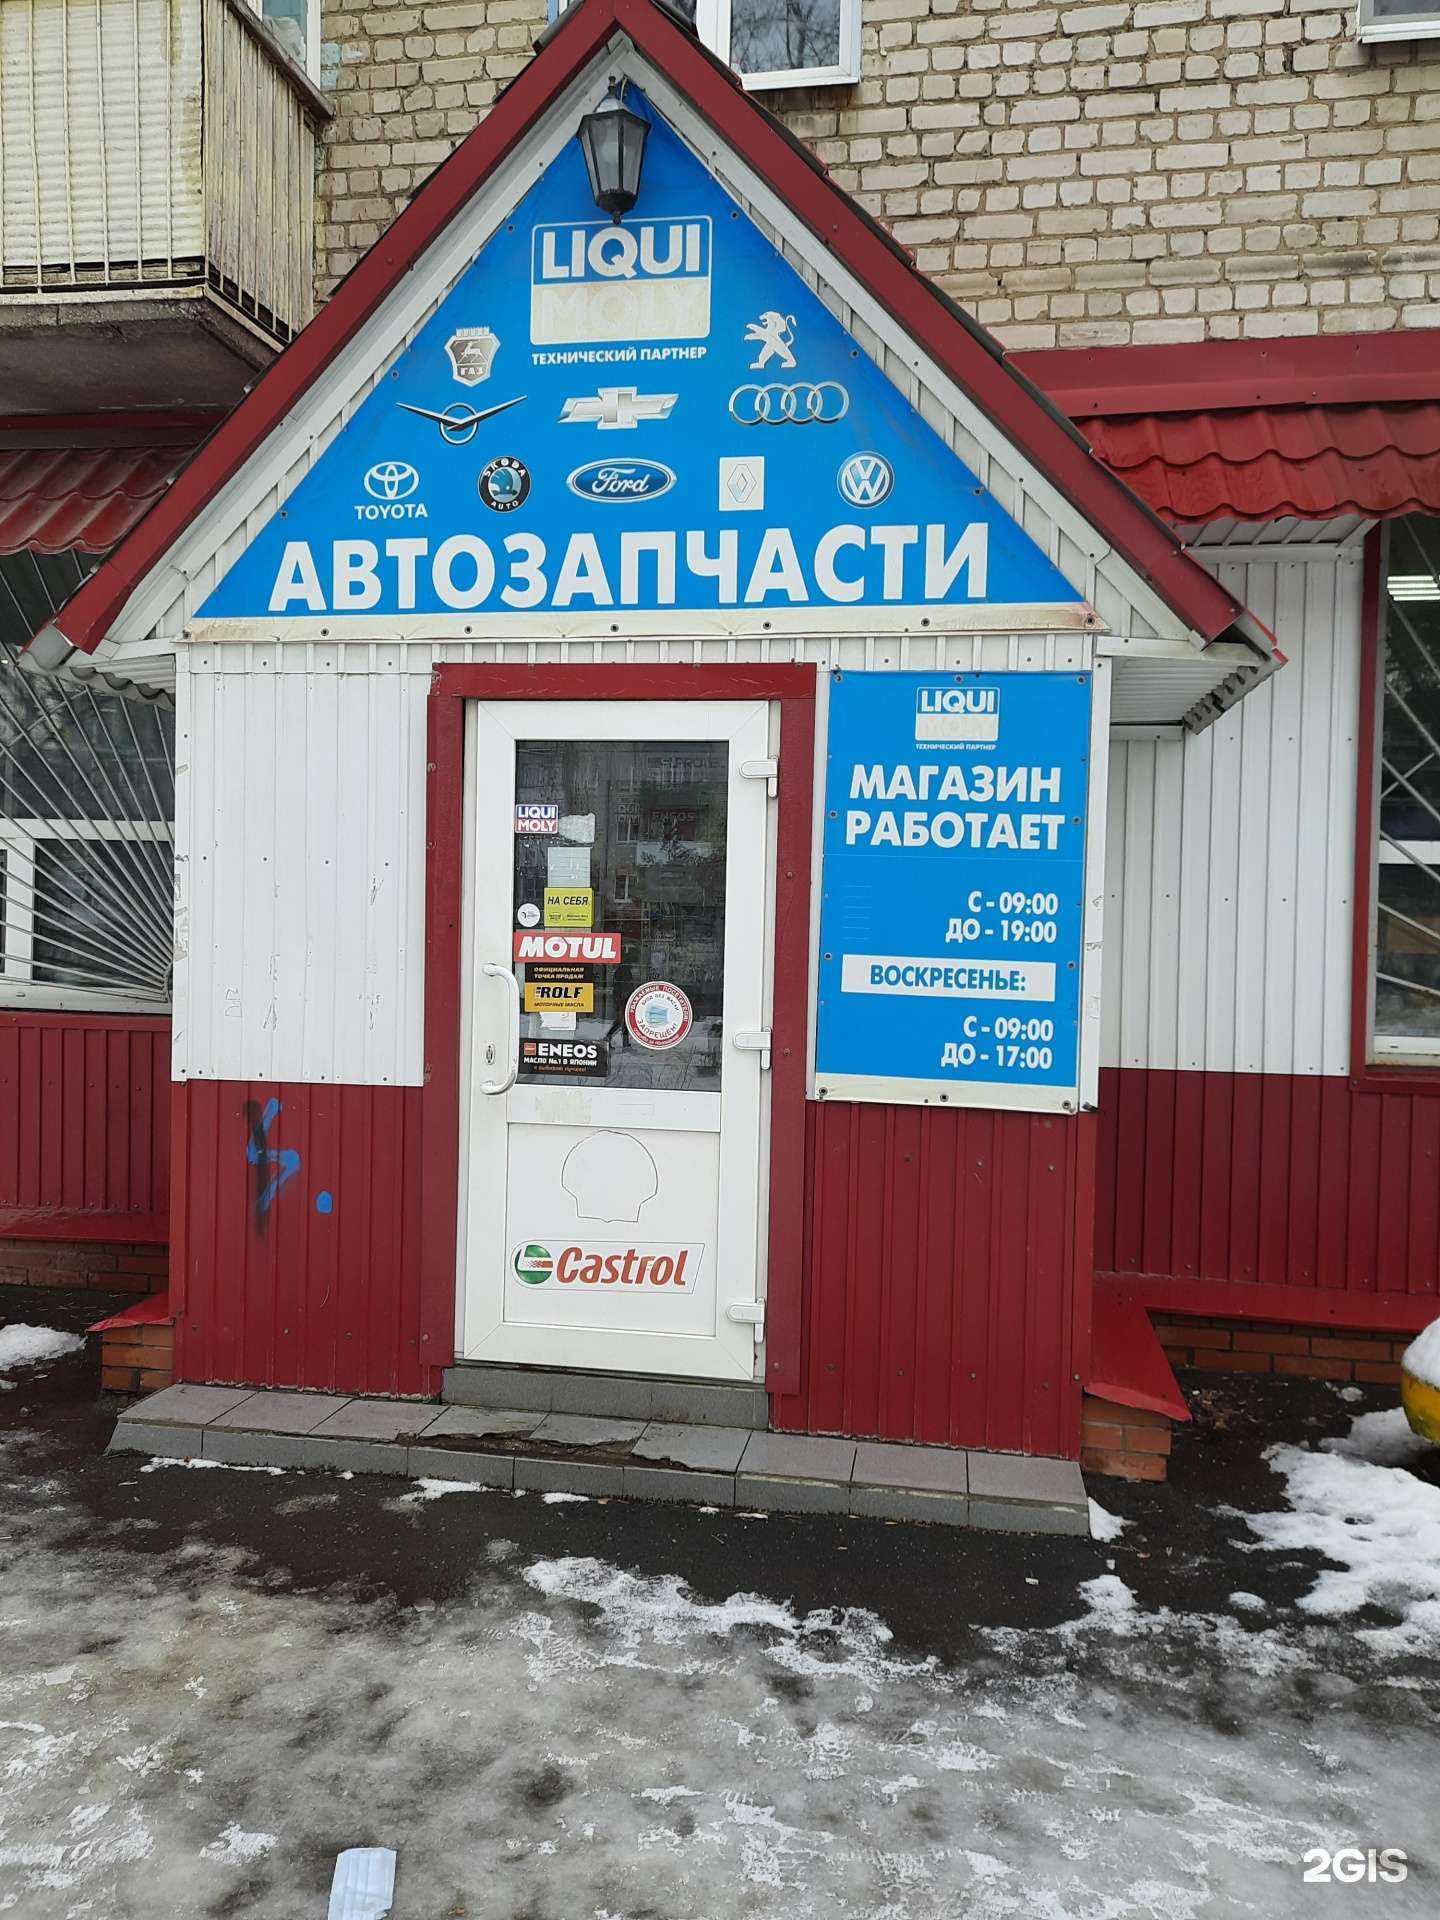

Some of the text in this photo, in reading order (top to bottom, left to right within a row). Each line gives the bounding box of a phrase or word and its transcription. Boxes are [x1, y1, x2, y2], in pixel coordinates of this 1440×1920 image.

[542, 223, 700, 280] LIQUI
[531, 346, 707, 366] ТЕХНИЧЕСКИЙ ПАРТНЕР
[592, 467, 649, 495] Ford
[354, 503, 428, 521] TOYOTA
[491, 500, 519, 510] AUTO
[268, 522, 989, 612] АВТОЗАПЧАСТИ
[921, 690, 995, 713] LIQUI
[915, 742, 997, 751] ТЕХНИЧЕСКИЙ ПАРТНЕР
[849, 763, 1061, 803] МАГАЗИН
[516, 805, 556, 819] LIQUI
[517, 819, 557, 833] MOLY
[845, 810, 1066, 850] РАБОТАЕТ
[547, 896, 589, 906] НА СЕБЯ
[998, 892, 1059, 915] 09:00
[945, 918, 981, 944] ДО
[1000, 919, 1057, 944] 19:00
[518, 936, 616, 959] MOTUL
[869, 964, 1027, 992] ВОСКРЕСЕНЬЕ:
[540, 986, 584, 999] ROLF
[993, 1017, 1054, 1042] 09:00
[537, 1042, 598, 1058] ENEOS
[940, 1042, 976, 1068] ДО
[996, 1045, 1053, 1070] 17:00
[523, 1057, 547, 1065] МАСЛО
[568, 1059, 597, 1067] ЯПОНИИ
[556, 1246, 689, 1286] Castrol
